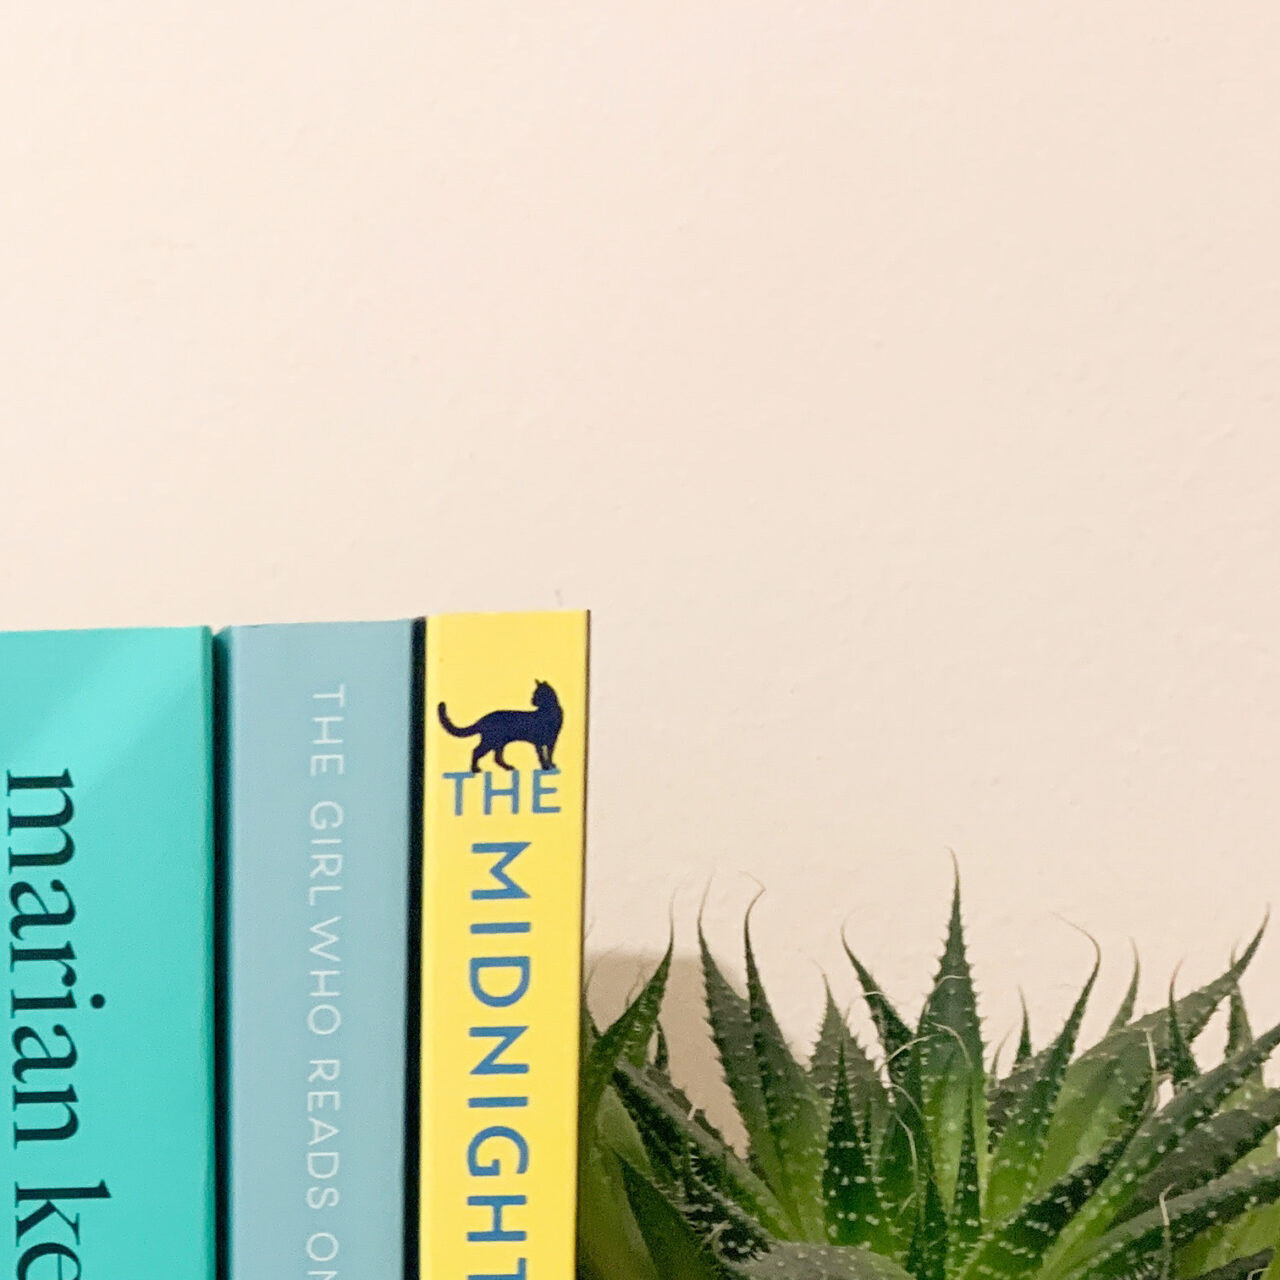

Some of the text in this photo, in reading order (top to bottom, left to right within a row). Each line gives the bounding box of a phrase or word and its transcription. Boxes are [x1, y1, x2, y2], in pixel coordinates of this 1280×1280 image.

[311, 684, 345, 776] THE
[442, 768, 561, 816] THE
[309, 801, 343, 906] GIRL
[6, 767, 106, 1150] marian
[308, 915, 341, 1035] WHO
[306, 1058, 340, 1209] READS
